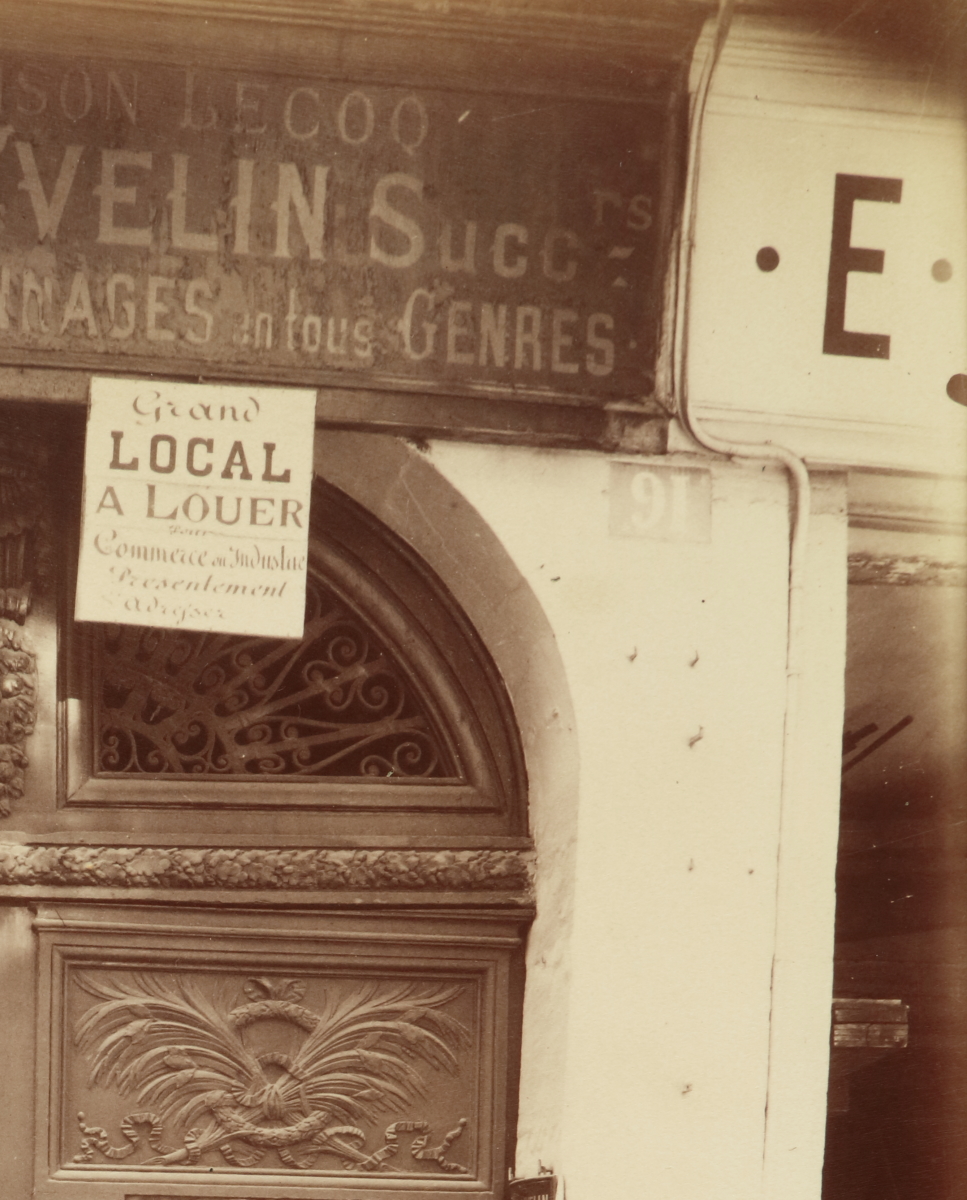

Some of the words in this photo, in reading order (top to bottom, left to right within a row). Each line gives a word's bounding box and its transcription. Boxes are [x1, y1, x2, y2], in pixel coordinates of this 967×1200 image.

[179, 65, 430, 156] LECOQ
[822, 172, 903, 360] E
[285, 286, 375, 358] tous
[397, 284, 616, 377] GENRES
[132, 390, 260, 424] Grand
[109, 430, 291, 483] LOCAL
[95, 485, 125, 516] A
[146, 483, 304, 529] LOUER
[630, 471, 691, 532] 91
[93, 529, 208, 568] Commerce
